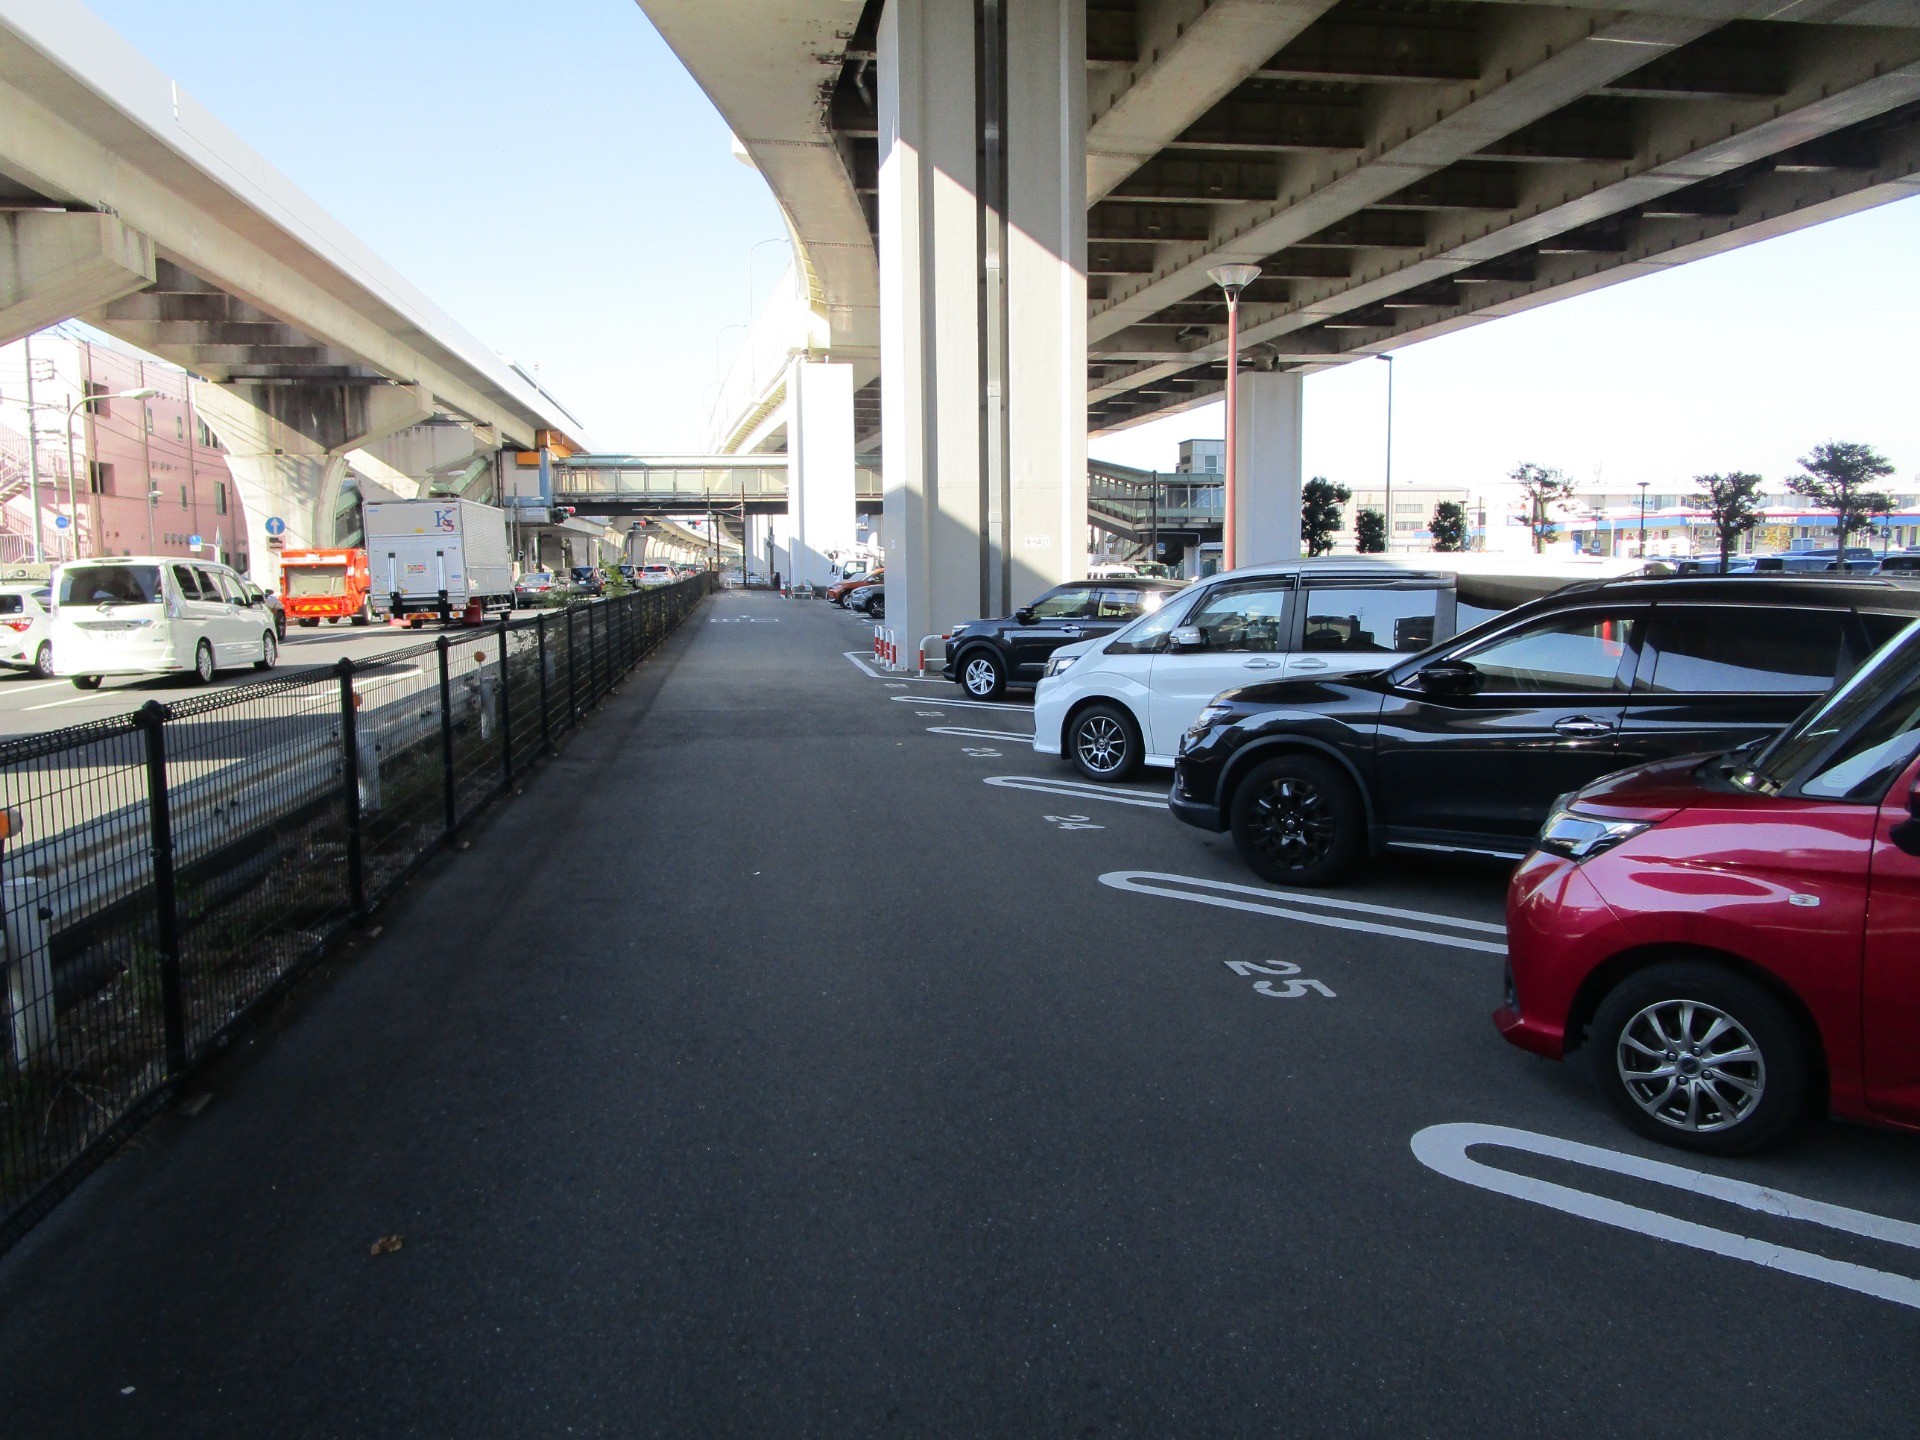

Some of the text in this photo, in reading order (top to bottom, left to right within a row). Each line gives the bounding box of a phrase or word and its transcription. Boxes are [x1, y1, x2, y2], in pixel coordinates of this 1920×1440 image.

[1765, 516, 1798, 524] MARKET
[1042, 815, 1106, 830] 24
[1223, 959, 1337, 998] 25
